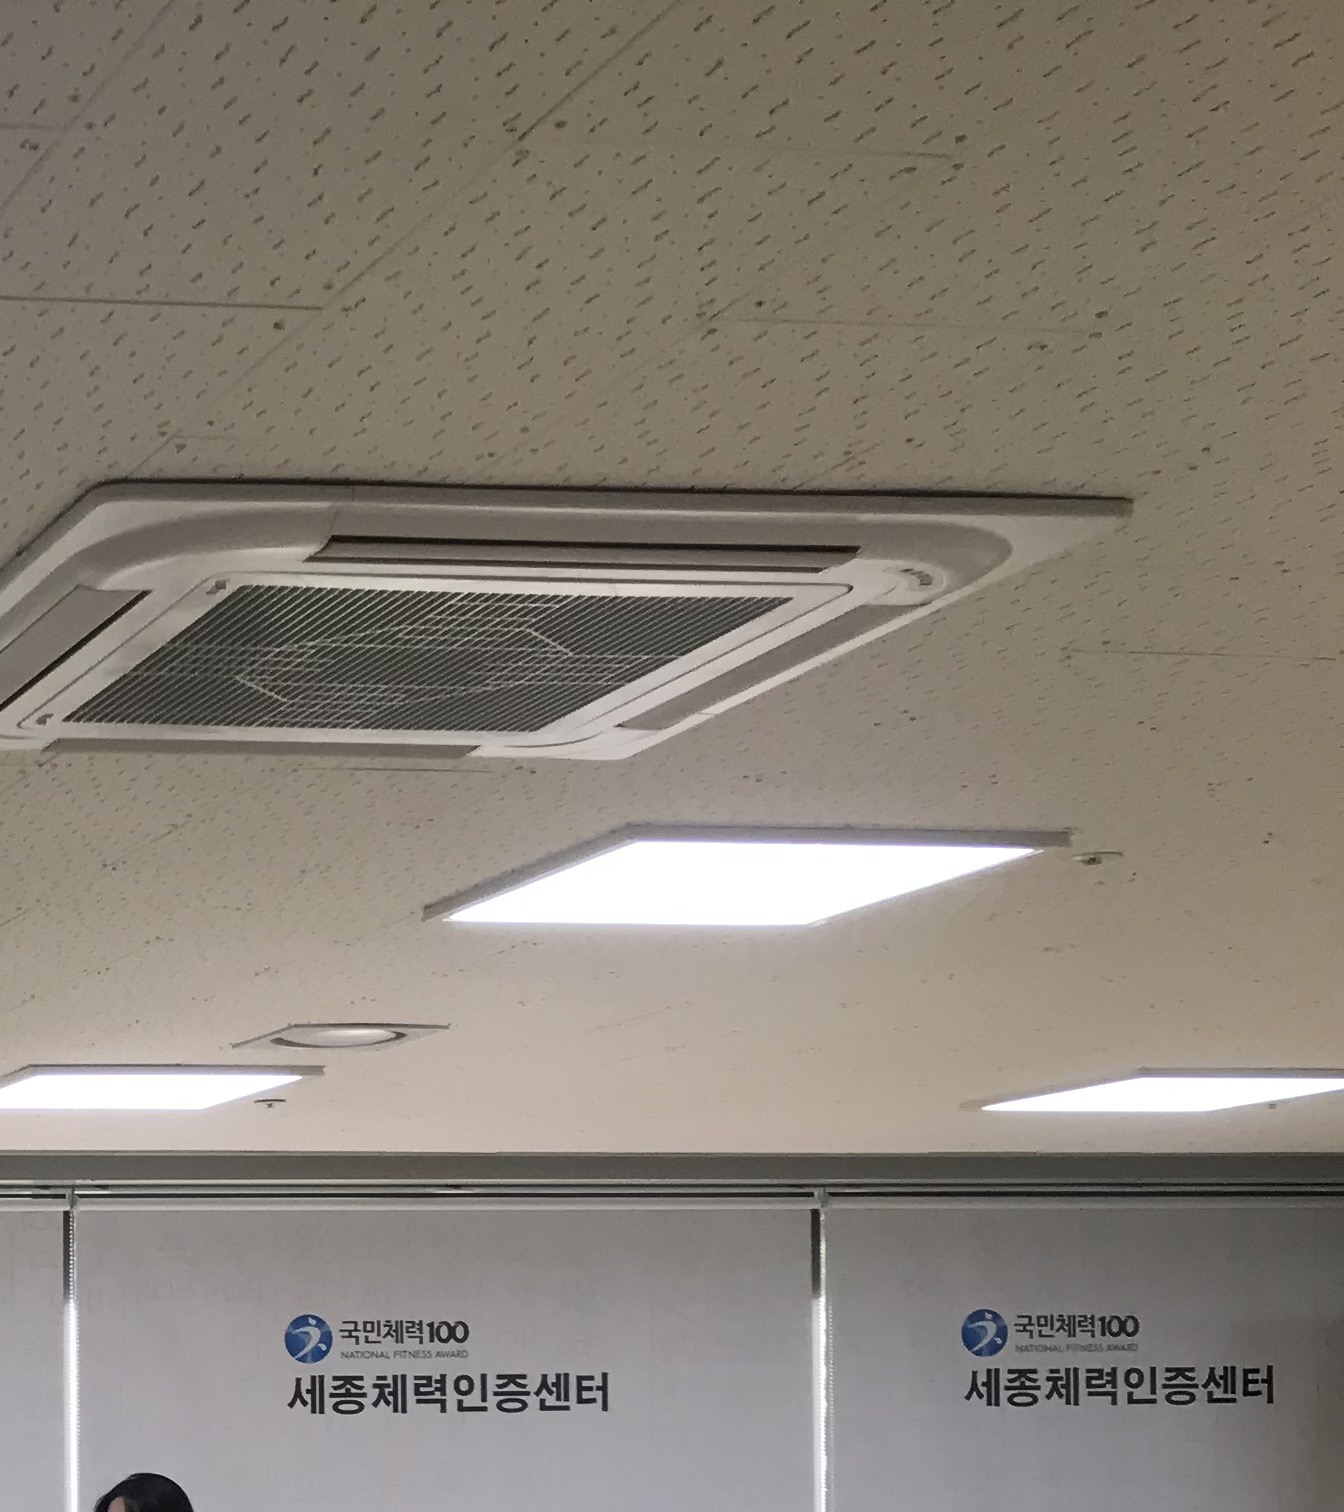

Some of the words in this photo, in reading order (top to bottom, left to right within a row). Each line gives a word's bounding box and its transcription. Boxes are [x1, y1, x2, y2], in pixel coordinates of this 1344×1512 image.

[339, 1319, 470, 1345] 국민체력100
[1014, 1314, 1140, 1339] 국민체력100
[340, 1350, 390, 1359] NATIONAL
[393, 1350, 432, 1359] FITNESS
[434, 1349, 469, 1359] AWARD
[288, 1372, 609, 1415] 세종체력인증센터
[964, 1365, 1274, 1407] 세종체력인증센터
